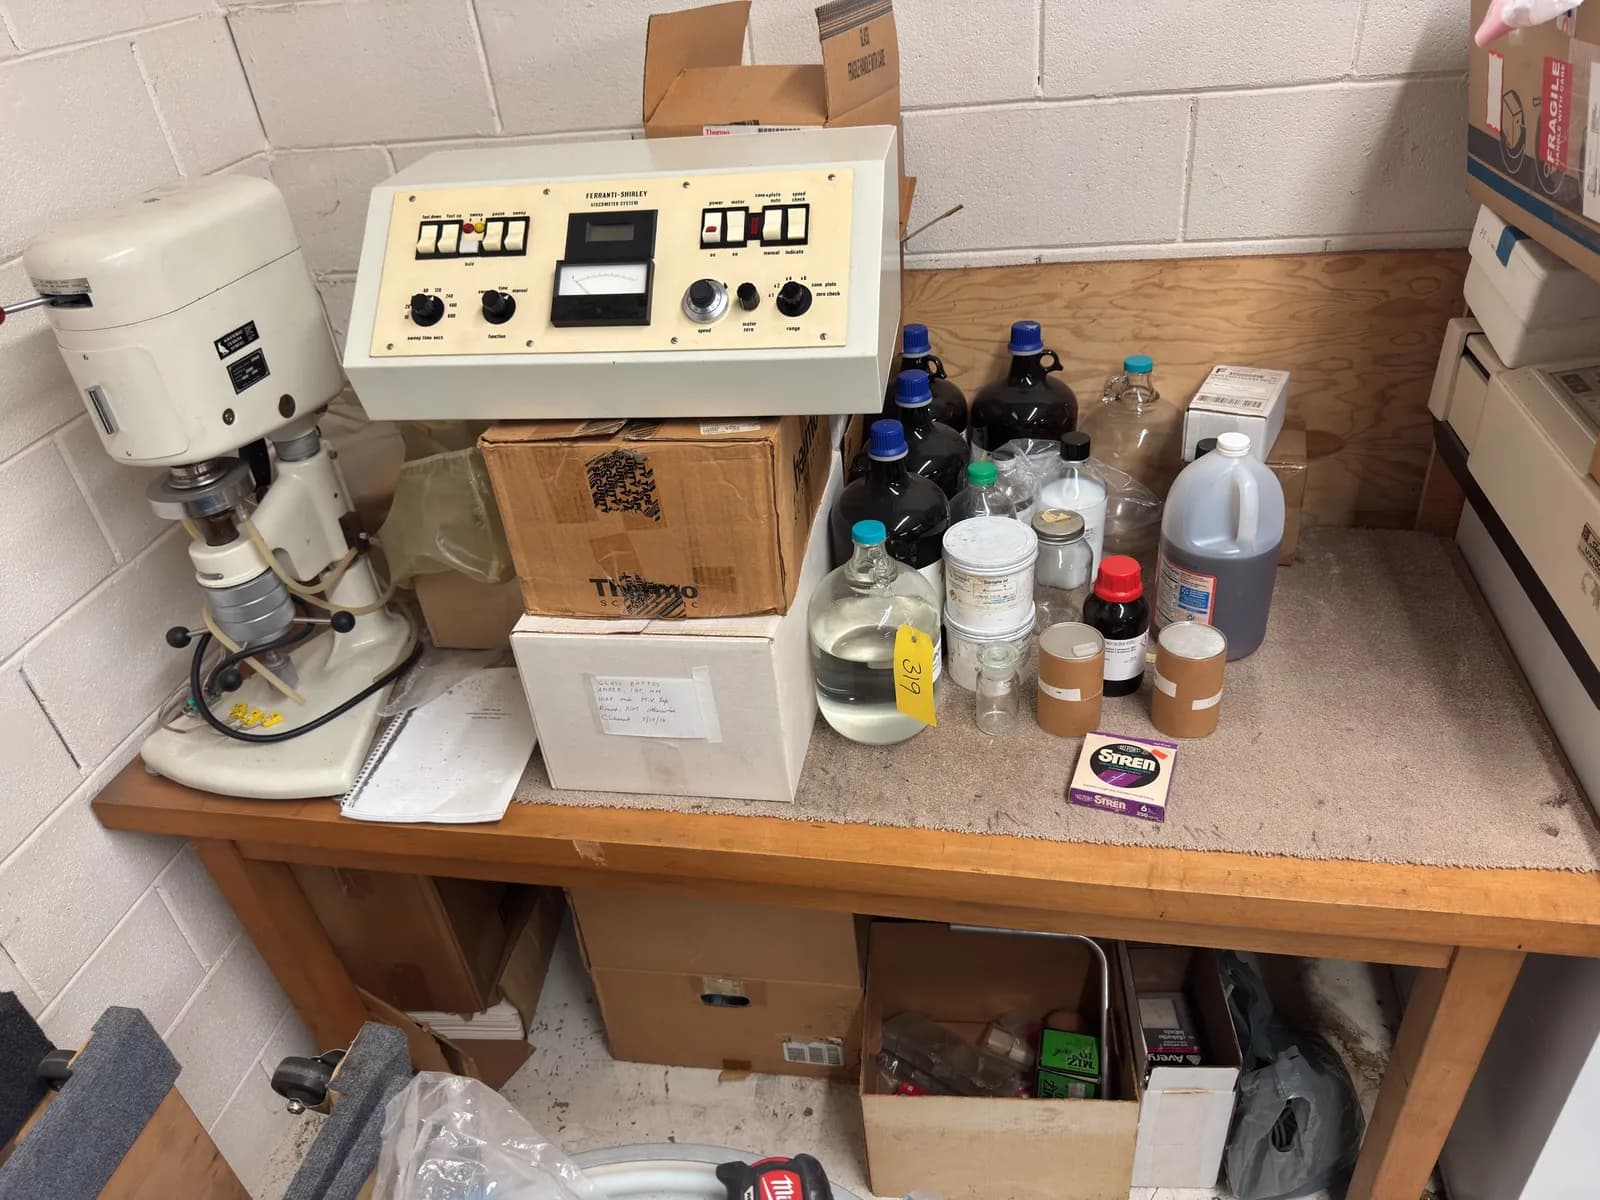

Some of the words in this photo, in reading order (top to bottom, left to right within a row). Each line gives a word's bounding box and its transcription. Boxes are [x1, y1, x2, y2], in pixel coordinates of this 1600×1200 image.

[1546, 61, 1561, 163] FRAGILE
[1557, 94, 1565, 122] WITH
[585, 190, 648, 199] FERRANTI-SHIRLEY
[900, 658, 922, 695] 319
[1148, 1053, 1183, 1064] Avery
